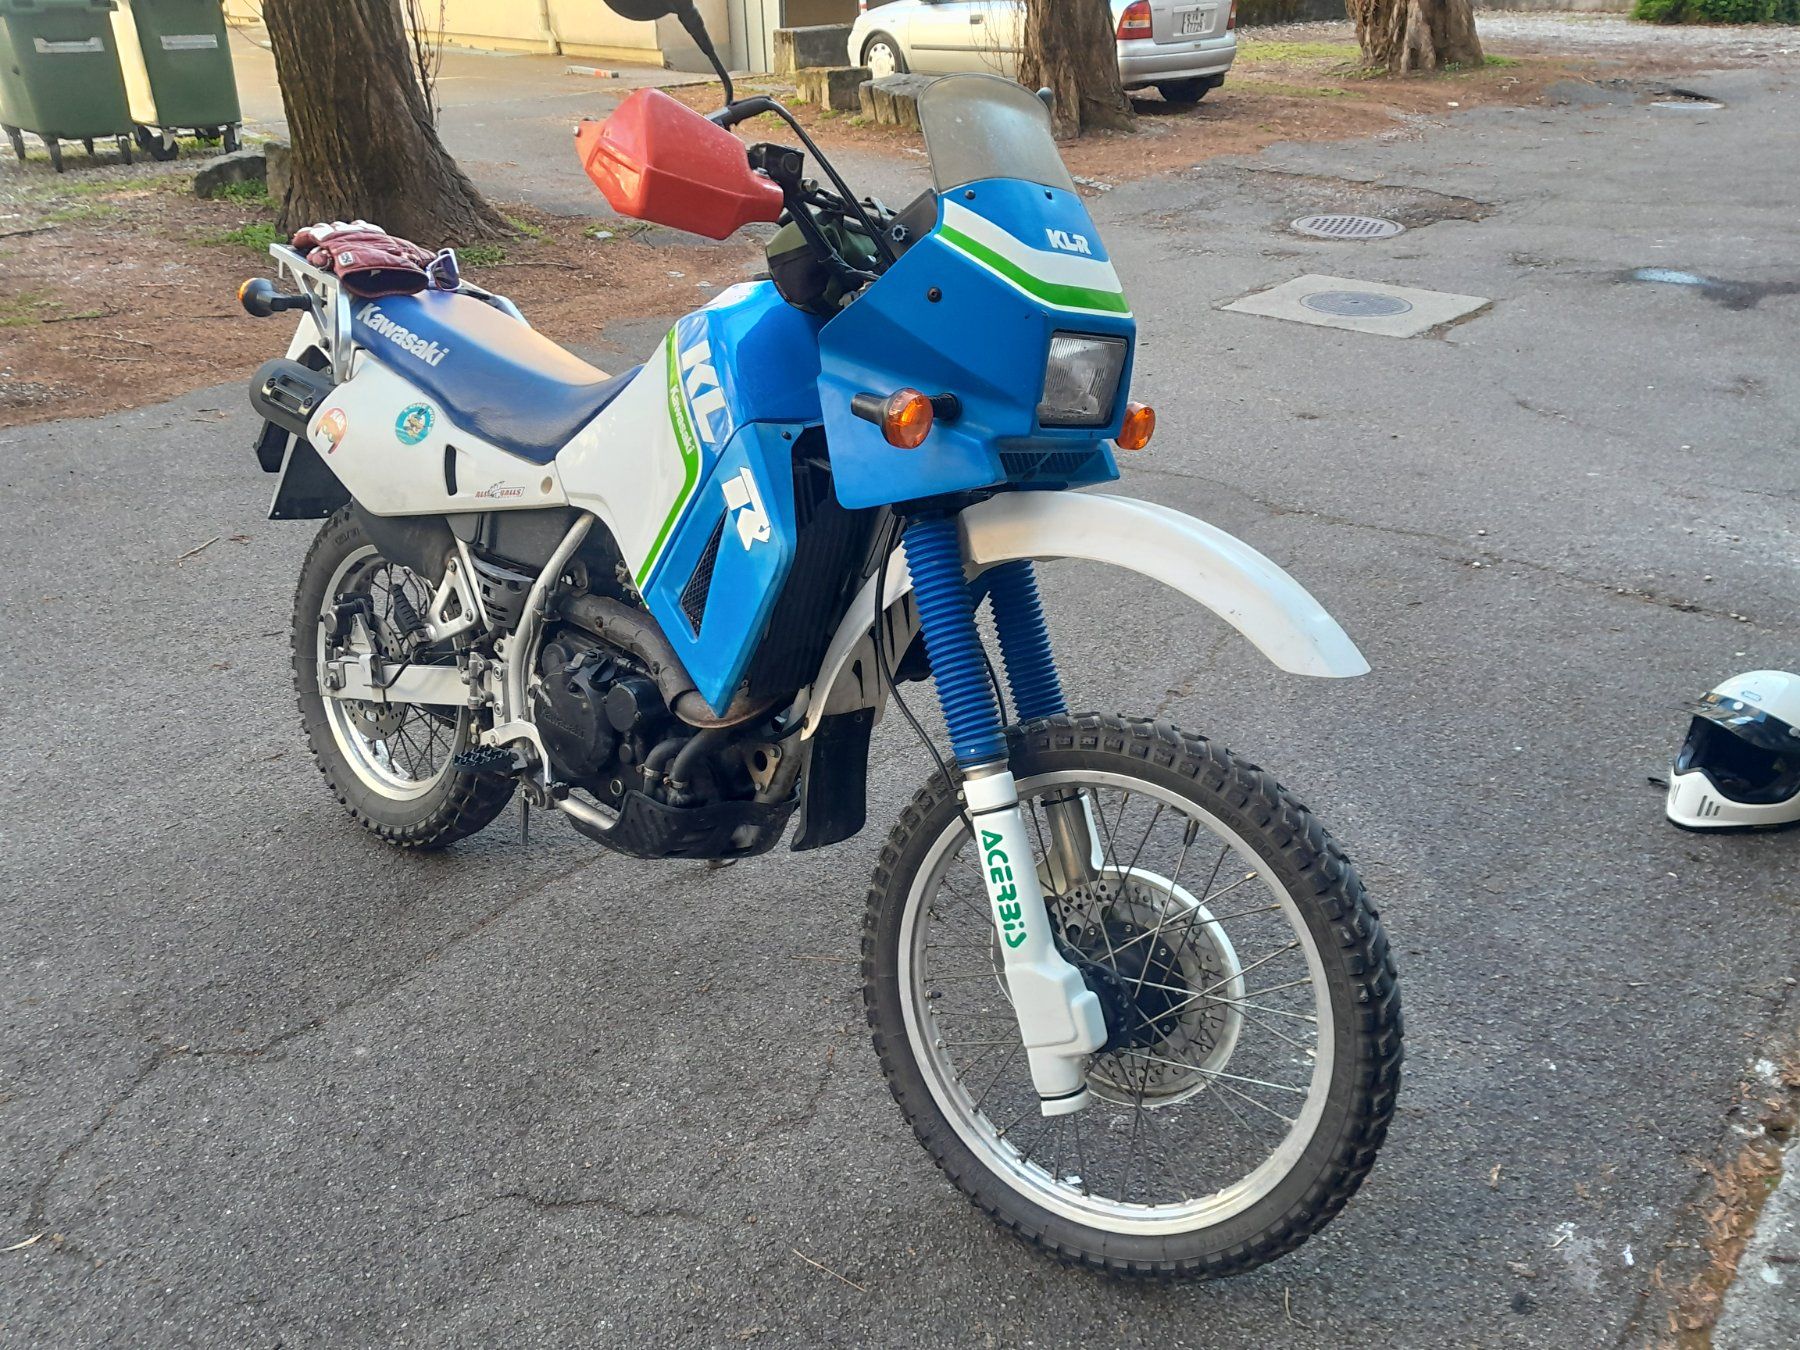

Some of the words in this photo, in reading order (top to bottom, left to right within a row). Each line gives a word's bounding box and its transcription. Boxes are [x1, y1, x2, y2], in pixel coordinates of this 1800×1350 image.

[1045, 228, 1092, 255] KLR
[355, 302, 450, 367] Kawasaki
[670, 384, 695, 455] Kawasaki
